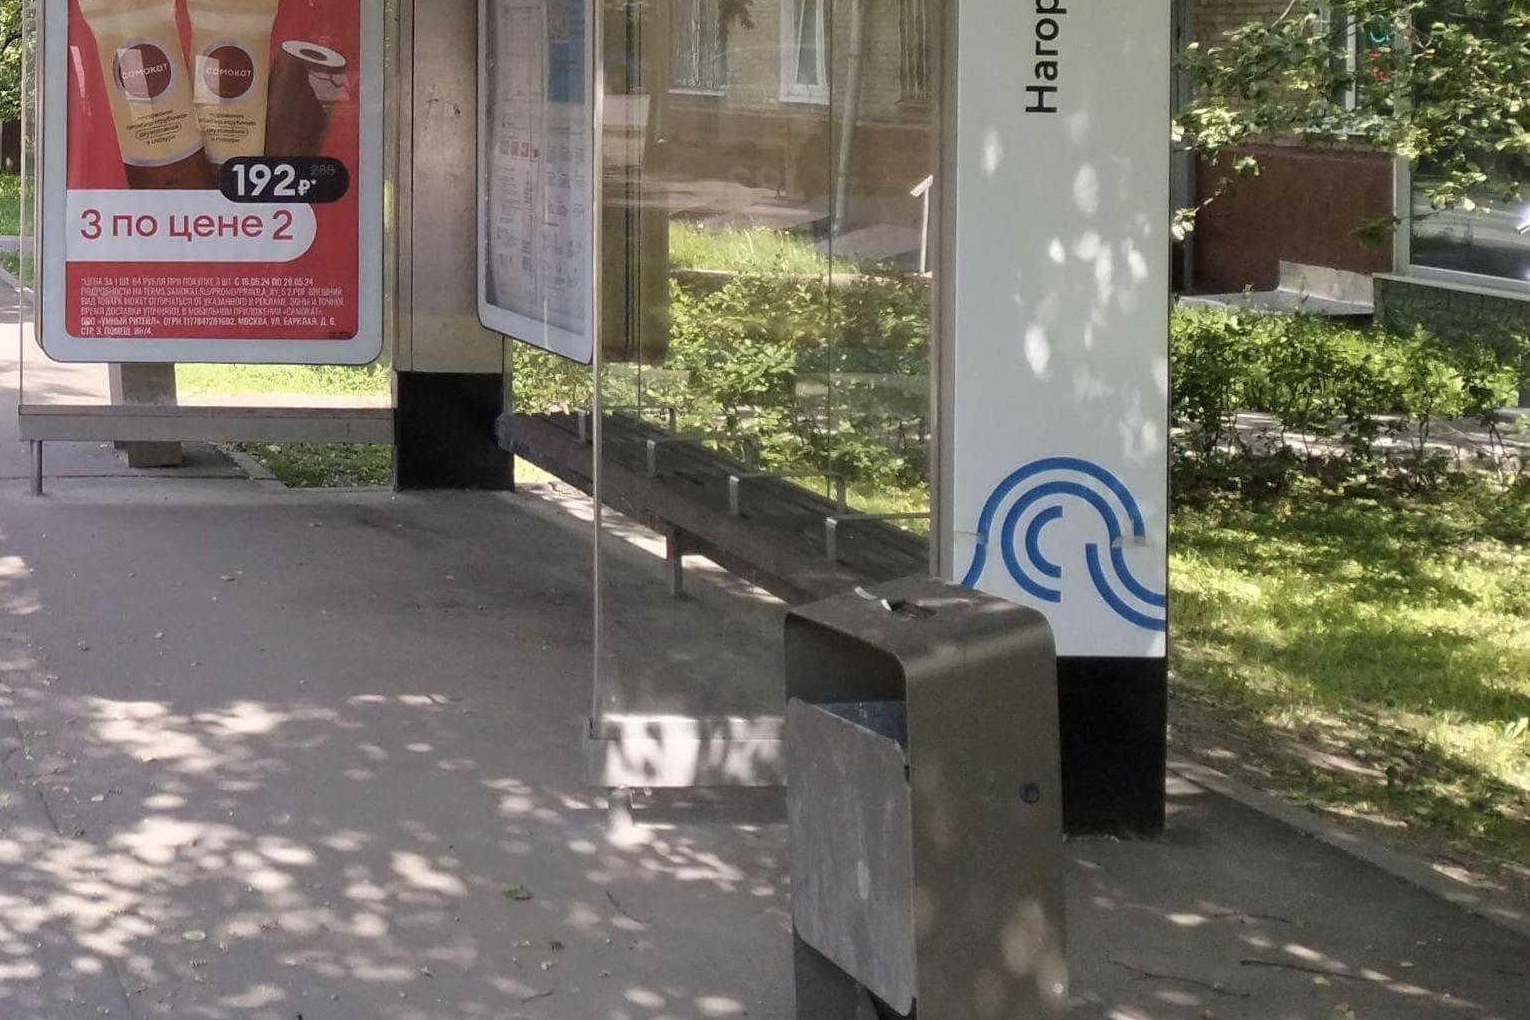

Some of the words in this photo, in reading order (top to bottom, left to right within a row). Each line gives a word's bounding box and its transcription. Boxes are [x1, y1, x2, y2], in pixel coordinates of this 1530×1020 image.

[80, 208, 103, 240] 3
[112, 214, 158, 237] по
[169, 214, 263, 242] цене
[272, 209, 293, 241] 2
